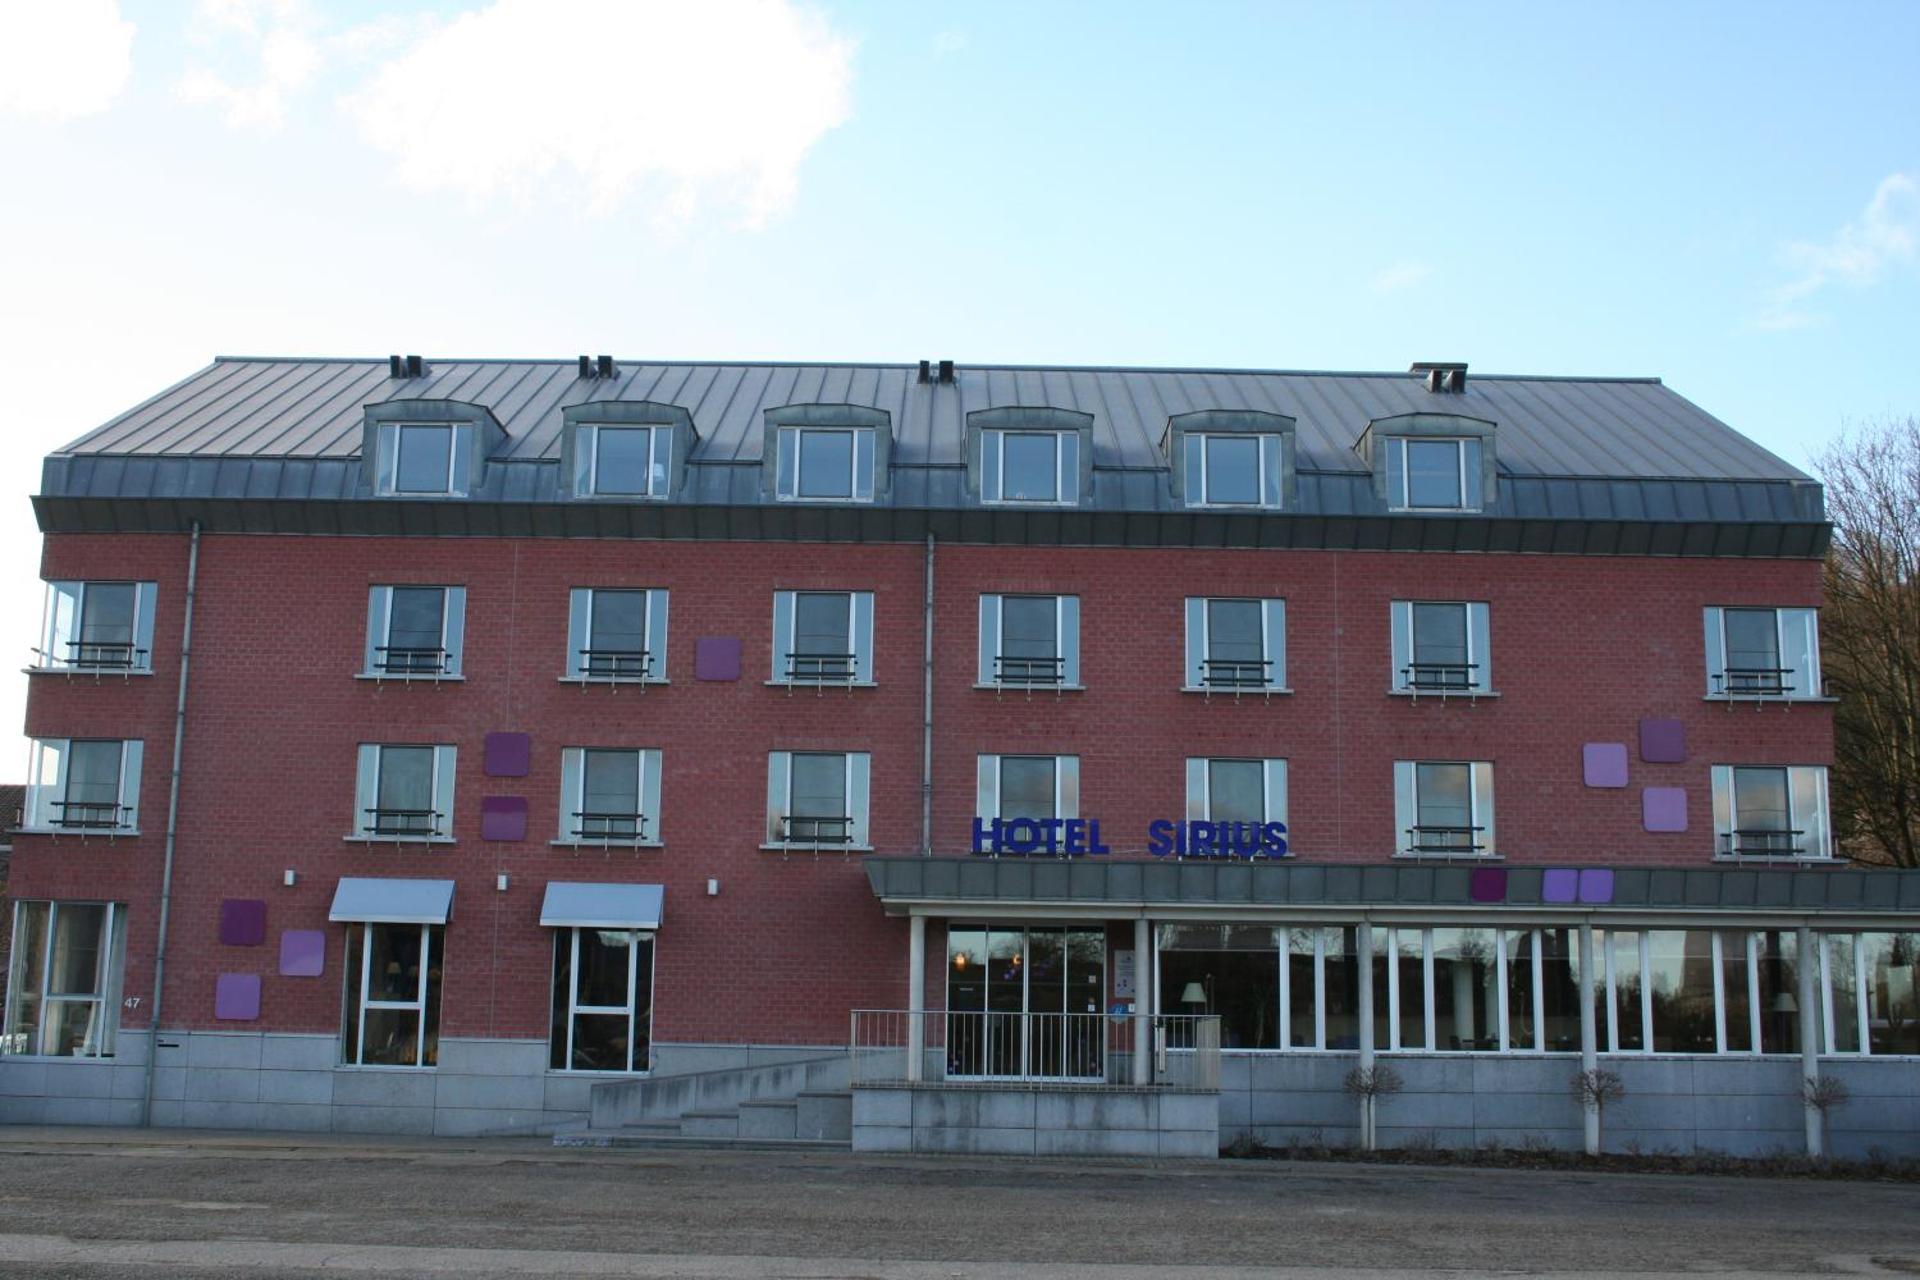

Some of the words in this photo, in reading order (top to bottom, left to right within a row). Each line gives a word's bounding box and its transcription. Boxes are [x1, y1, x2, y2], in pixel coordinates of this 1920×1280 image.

[972, 817, 1109, 855] HOTEL
[1148, 819, 1288, 859] SIRIUS
[124, 997, 140, 1009] 47
